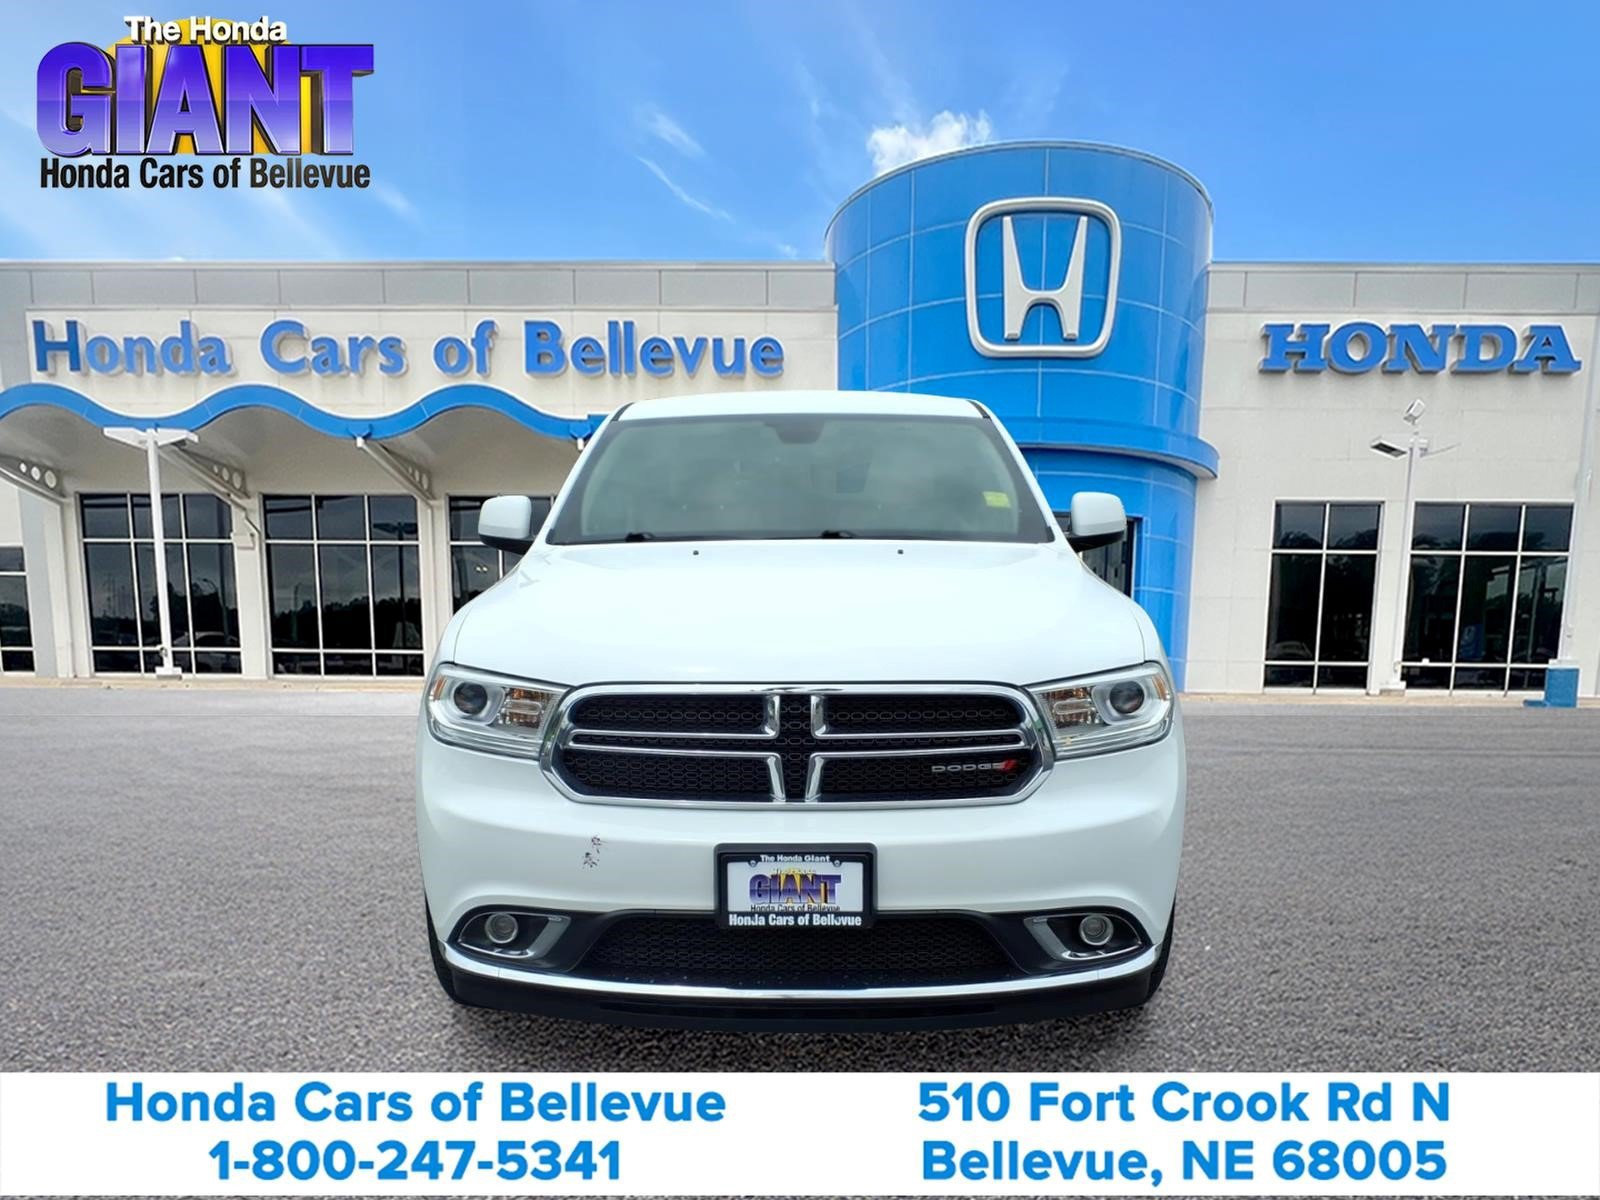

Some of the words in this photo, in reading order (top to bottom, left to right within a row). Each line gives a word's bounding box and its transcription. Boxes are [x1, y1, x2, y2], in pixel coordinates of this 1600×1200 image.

[32, 319, 233, 376] Honda
[260, 320, 408, 377] Cars
[432, 319, 497, 376] of
[523, 319, 786, 378] Bellevue
[1259, 322, 1582, 375] HONDA
[931, 763, 1003, 772] DODGE
[760, 854, 775, 863] The
[777, 854, 803, 863] Honda
[804, 854, 831, 863] Giant
[749, 874, 842, 904] GIANT
[768, 913, 795, 926] Cars
[797, 913, 810, 926] of
